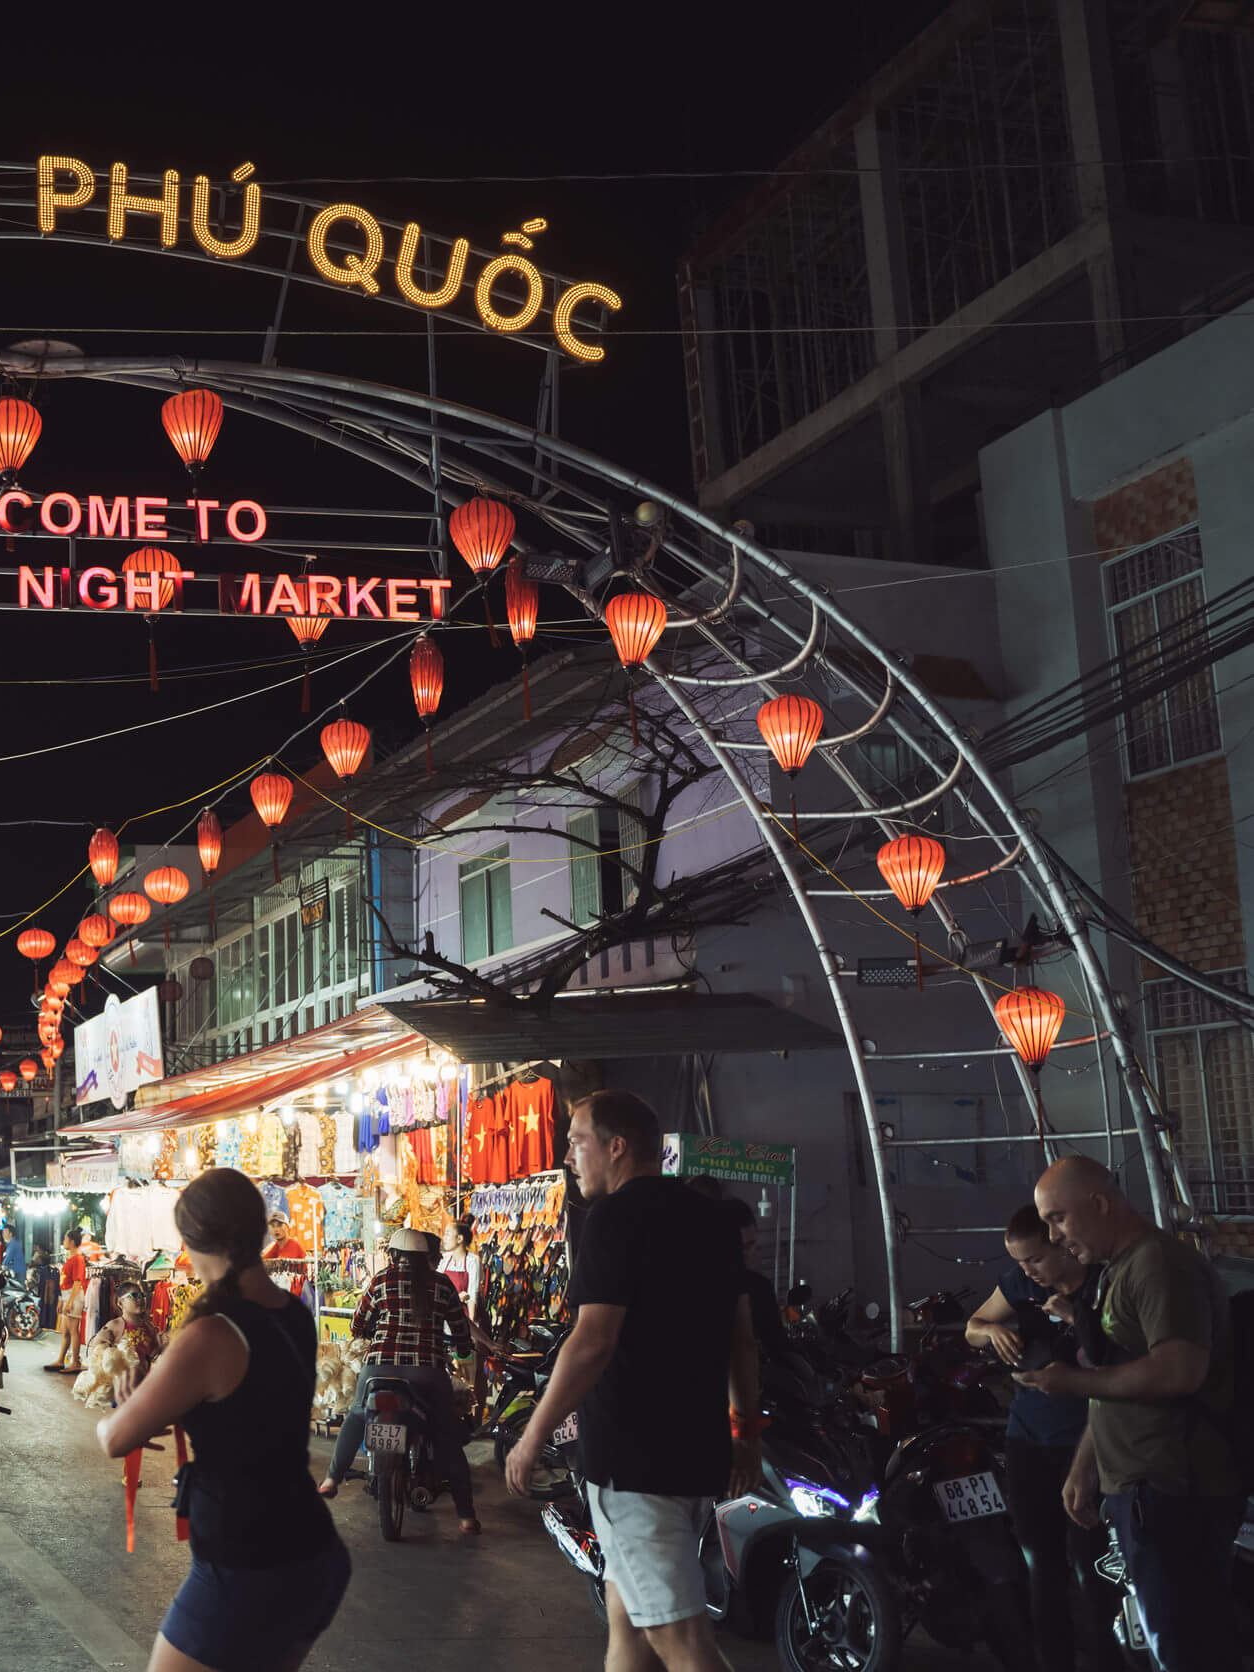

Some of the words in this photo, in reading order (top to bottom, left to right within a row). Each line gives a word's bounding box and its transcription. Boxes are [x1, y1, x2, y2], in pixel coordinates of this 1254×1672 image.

[37, 155, 262, 259] PHÚ
[307, 203, 622, 362] QUỐC
[187, 498, 267, 543] TO
[18, 566, 195, 613] NIGHT
[219, 572, 452, 620] MARKET
[709, 1167, 748, 1181] CREAM
[371, 1424, 402, 1438] 52-L7
[944, 1475, 989, 1500] 68-P1
[948, 1493, 1003, 1520] 448.54
